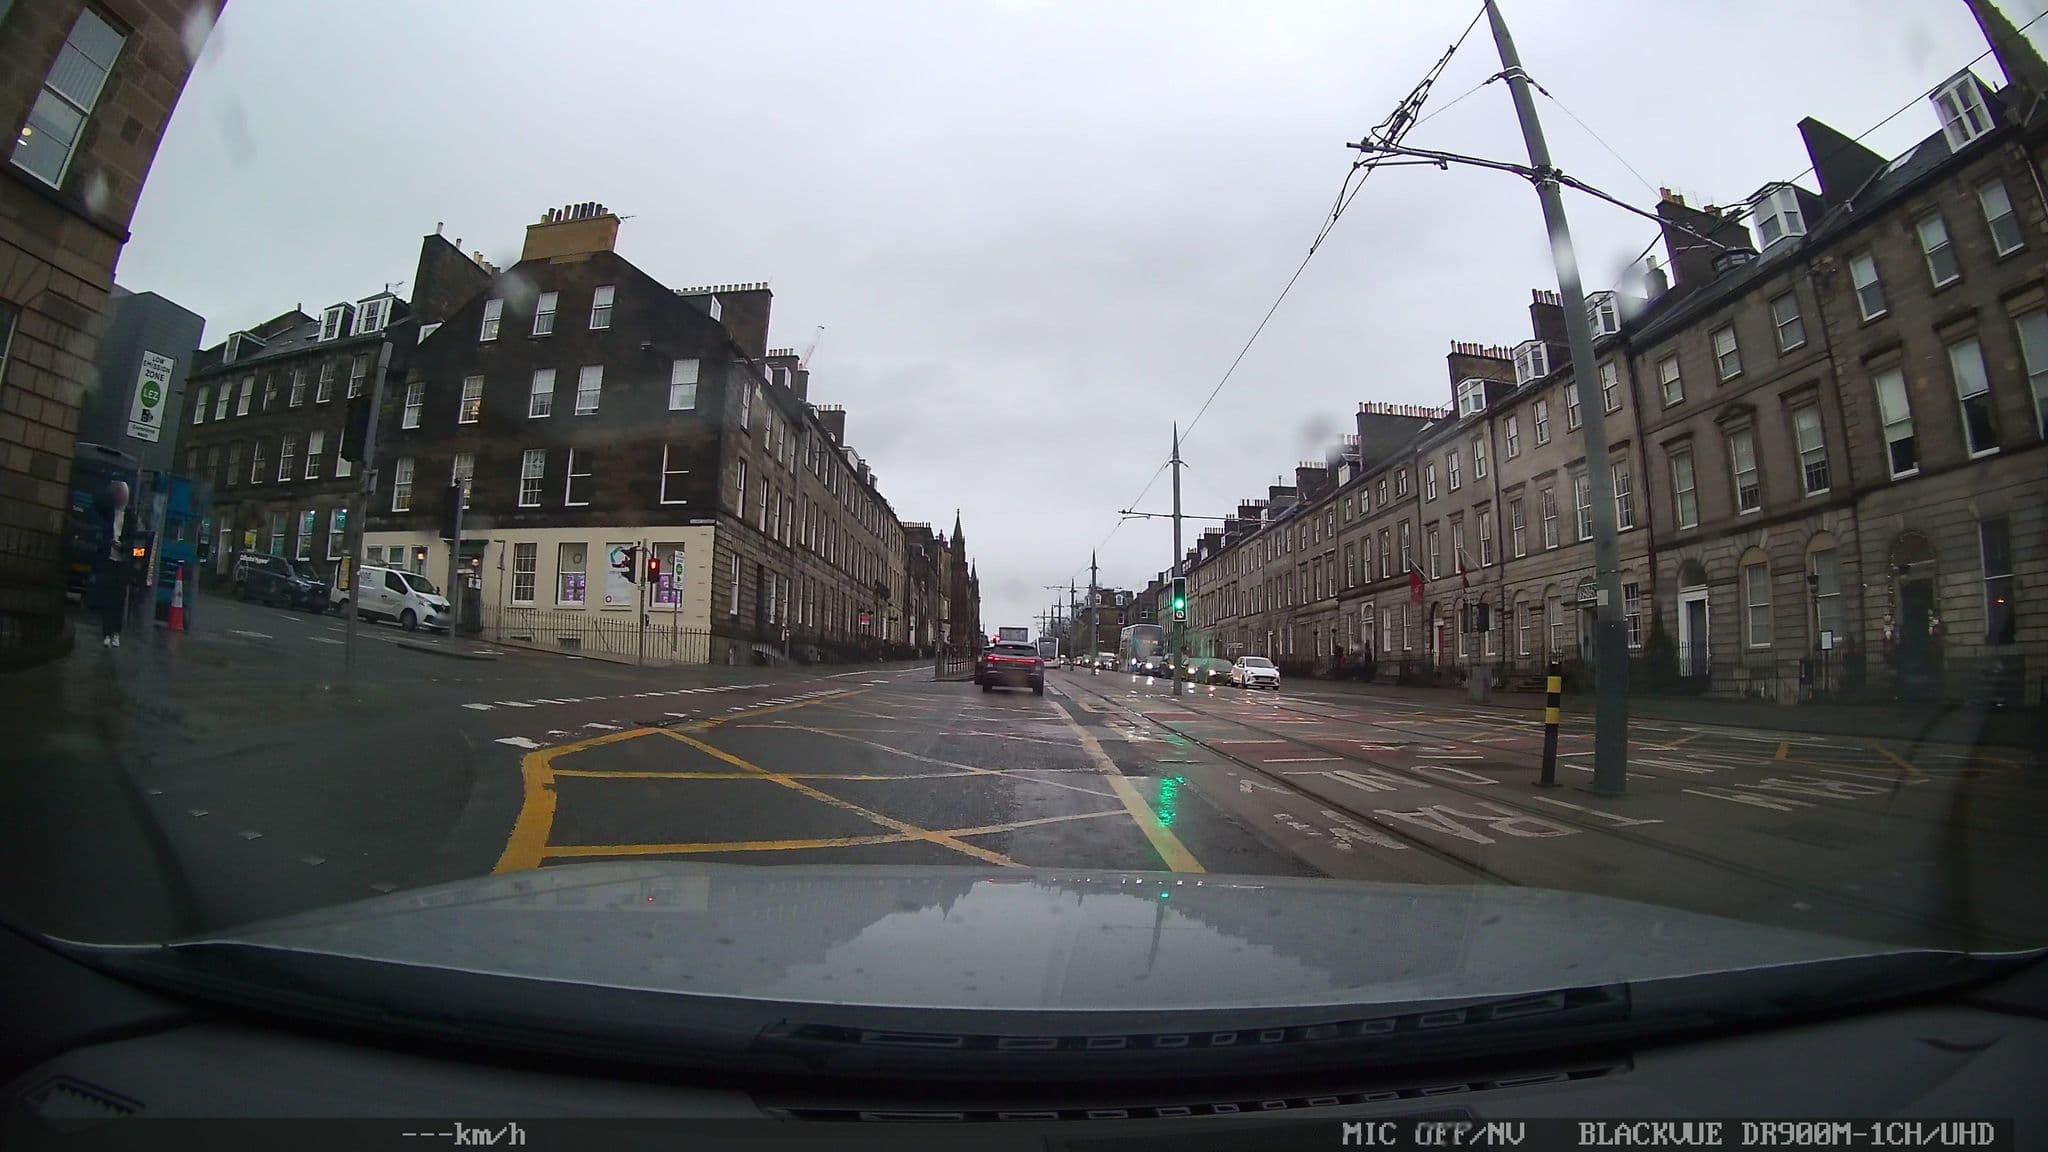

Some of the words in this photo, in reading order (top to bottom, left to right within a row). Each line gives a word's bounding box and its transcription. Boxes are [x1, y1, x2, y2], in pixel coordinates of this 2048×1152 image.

[152, 356, 165, 365] LOW
[145, 369, 165, 381] ZONE
[143, 387, 159, 400] LEZ
